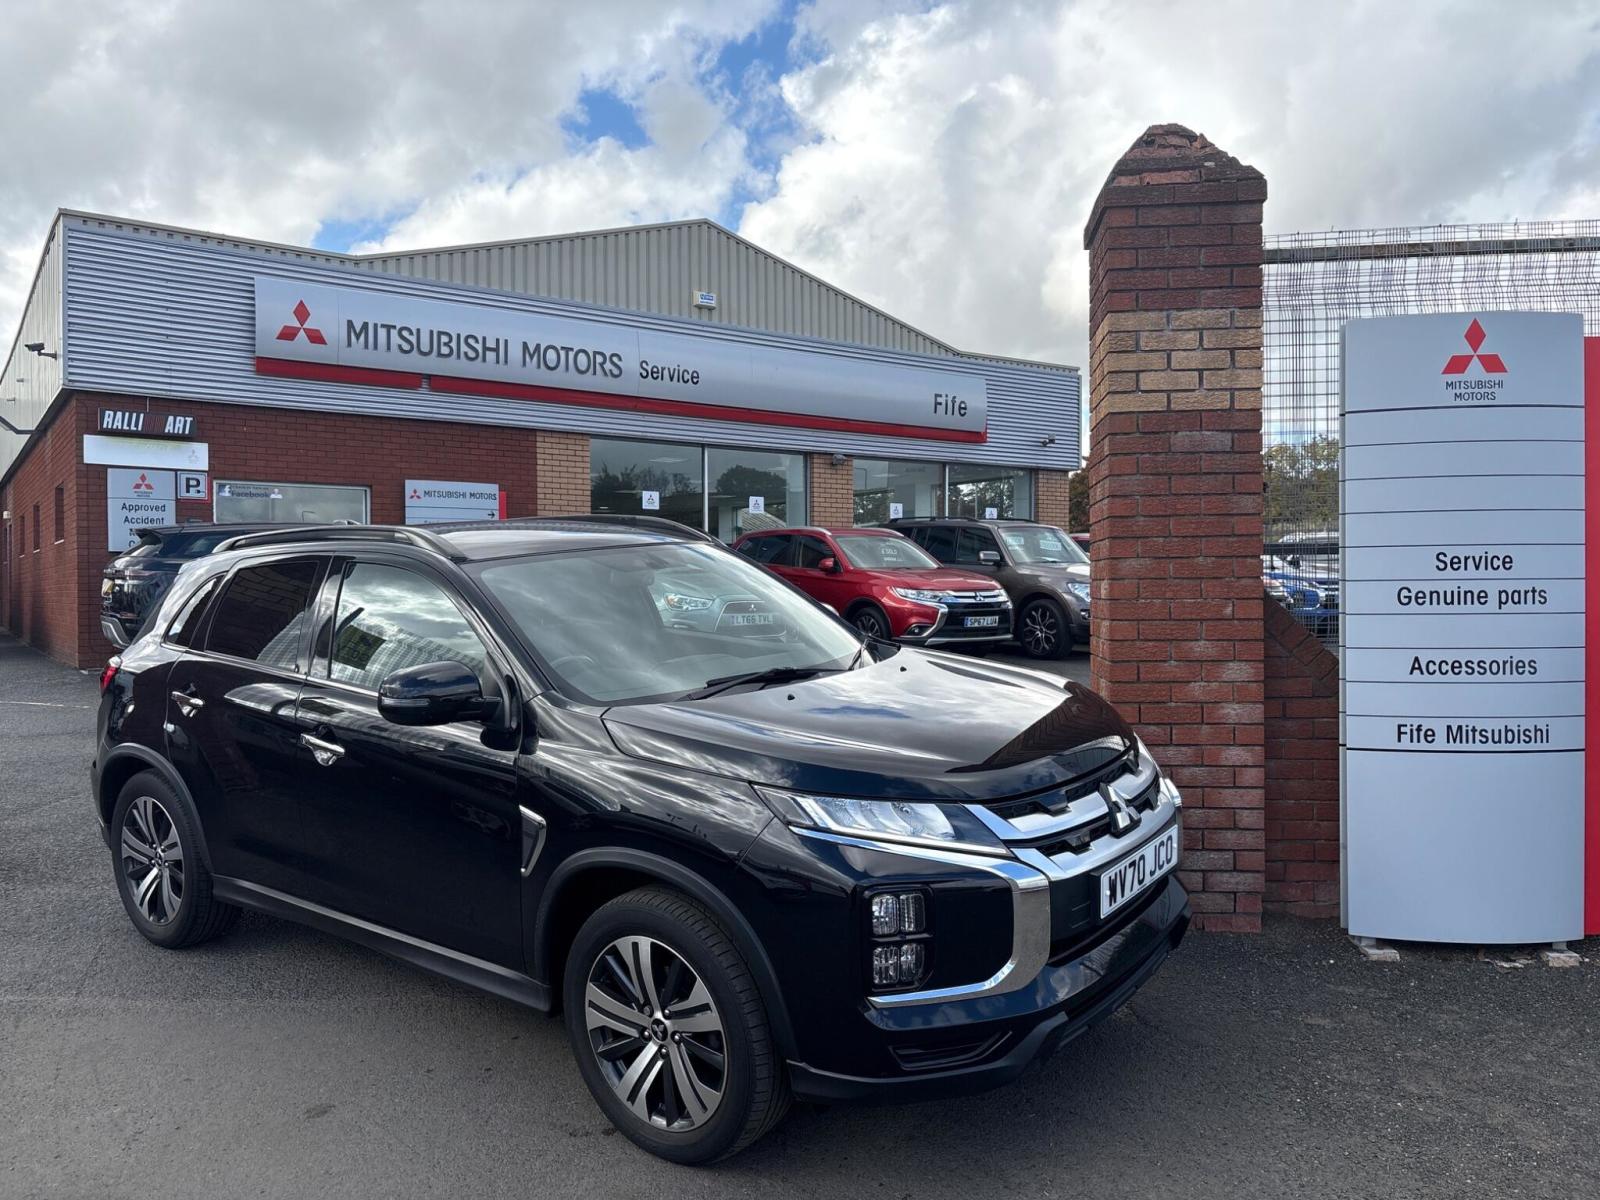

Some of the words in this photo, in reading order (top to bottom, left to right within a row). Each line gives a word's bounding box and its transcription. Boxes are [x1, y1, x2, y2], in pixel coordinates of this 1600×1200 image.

[346, 319, 509, 365] MITSUBISHI
[522, 341, 623, 379] MOTORS
[639, 360, 700, 385] Service
[1446, 380, 1504, 390] MITSUBISHI
[934, 393, 967, 417] Fife
[1454, 391, 1497, 401] MOTORS
[103, 410, 144, 431] RALLI
[165, 415, 193, 434] ART
[231, 490, 270, 498] Facebook
[424, 490, 467, 499] MITSUBISHI
[469, 492, 497, 500] MOTORS
[121, 502, 166, 512] Approved
[123, 515, 164, 525] Accident
[1435, 551, 1513, 571] Service
[1397, 586, 1489, 606] Genuine
[1498, 586, 1548, 610] parts
[1409, 656, 1538, 676] Accessories
[1397, 724, 1436, 744] Fife
[1446, 724, 1550, 745] Mitsubishi
[1108, 854, 1146, 907] WV70
[1150, 835, 1173, 877] JCO
